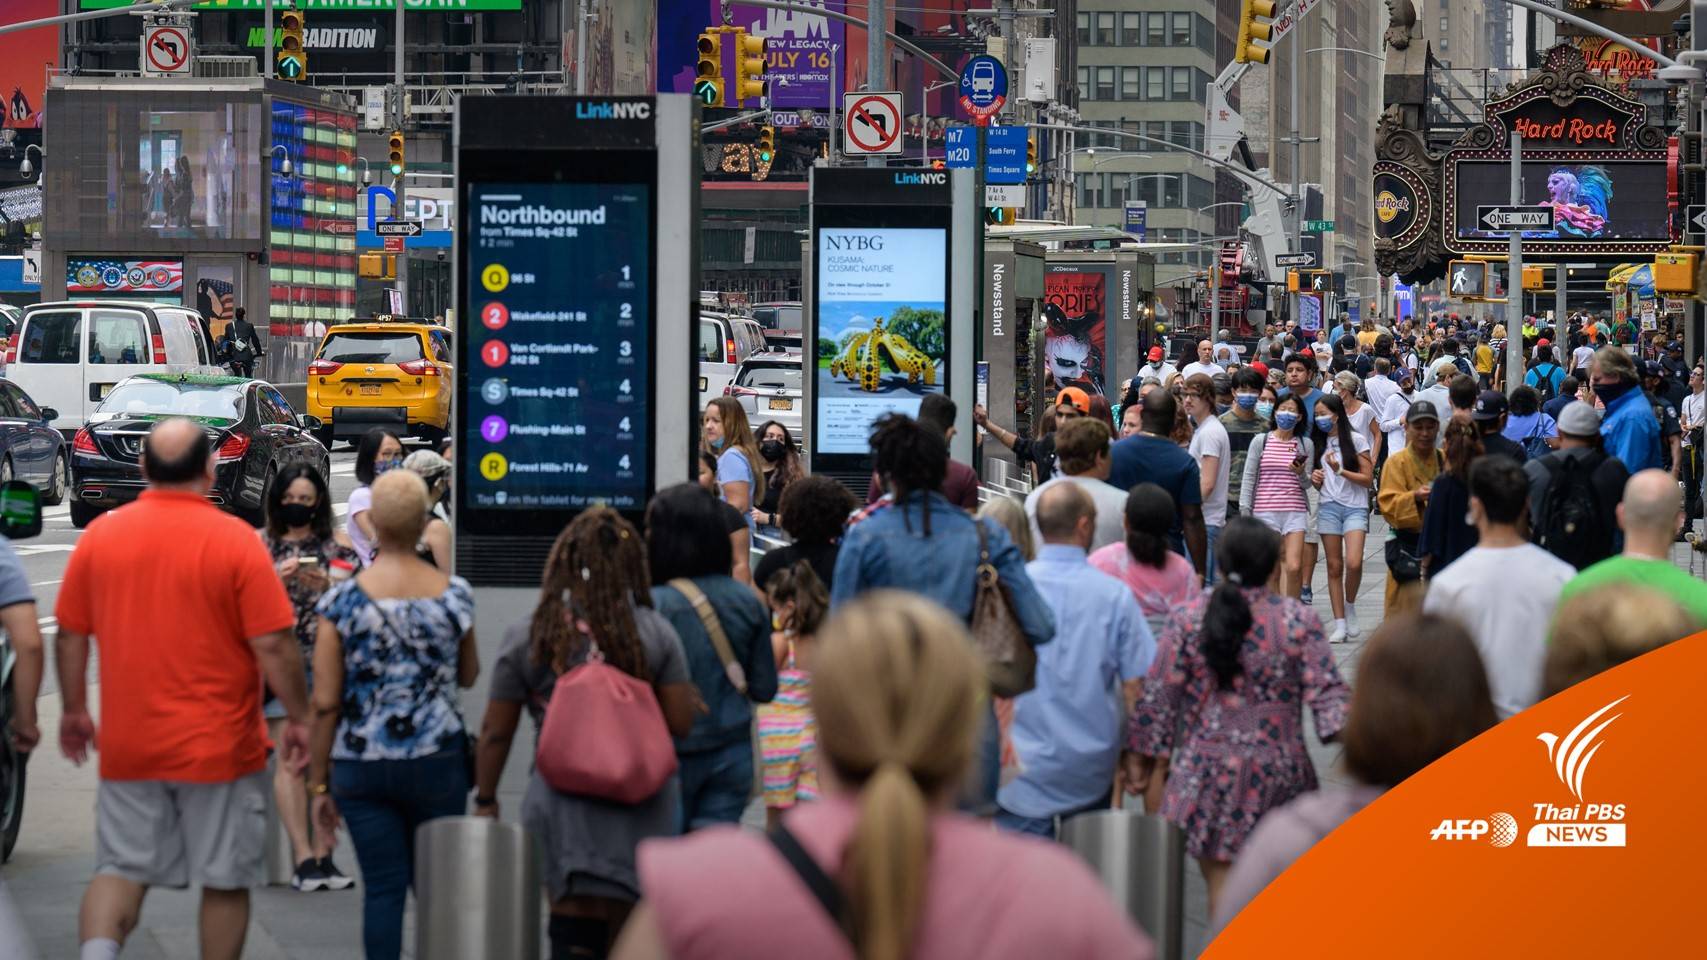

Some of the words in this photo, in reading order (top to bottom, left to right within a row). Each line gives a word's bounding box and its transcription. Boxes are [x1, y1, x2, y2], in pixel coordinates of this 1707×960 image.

[752, 0, 830, 38] JAM
[302, 28, 377, 48] RADITION
[789, 40, 830, 49] LEGACY
[808, 52, 830, 68] 16
[576, 102, 650, 119] LinkNYC
[972, 98, 1001, 115] STANDING
[948, 129, 963, 142] M7
[1515, 118, 1566, 138] Hard
[1569, 118, 1617, 144] Rock
[948, 148, 970, 161] M20
[895, 173, 946, 184] LinkNYC
[1386, 197, 1409, 210] Rock
[481, 205, 606, 224] Northbound
[1489, 214, 1511, 224] ONE
[1521, 214, 1544, 224] WAY
[480, 227, 502, 238] from
[504, 227, 533, 237] Times
[535, 227, 564, 239] Sq-42
[566, 227, 578, 237] St
[1309, 222, 1316, 230] W
[1318, 222, 1325, 230] 43
[826, 235, 884, 250] NYBG
[489, 271, 502, 285] Q
[524, 273, 535, 283] St
[621, 265, 630, 280] 1
[993, 264, 1005, 336] Newsstand
[1122, 270, 1131, 320] Newsstand
[489, 308, 500, 324] 2
[576, 311, 587, 321] St
[620, 303, 632, 318] 2
[490, 347, 499, 361] 1
[510, 343, 528, 353] Van
[620, 341, 631, 356] 3
[529, 355, 540, 365] St
[488, 383, 500, 399] S
[510, 387, 538, 397] Times
[540, 387, 567, 398] Sq-42
[568, 387, 579, 397] St
[619, 379, 631, 394] 4
[489, 422, 499, 437] 7
[510, 424, 574, 436] Flushing-Main
[575, 425, 586, 435] St
[619, 416, 631, 432] 4
[489, 461, 499, 473] R
[509, 462, 539, 472] Forest
[575, 463, 588, 472] Av
[619, 454, 631, 470] 4
[477, 494, 495, 506] Tap
[541, 494, 570, 504] tablet
[571, 494, 584, 504] for
